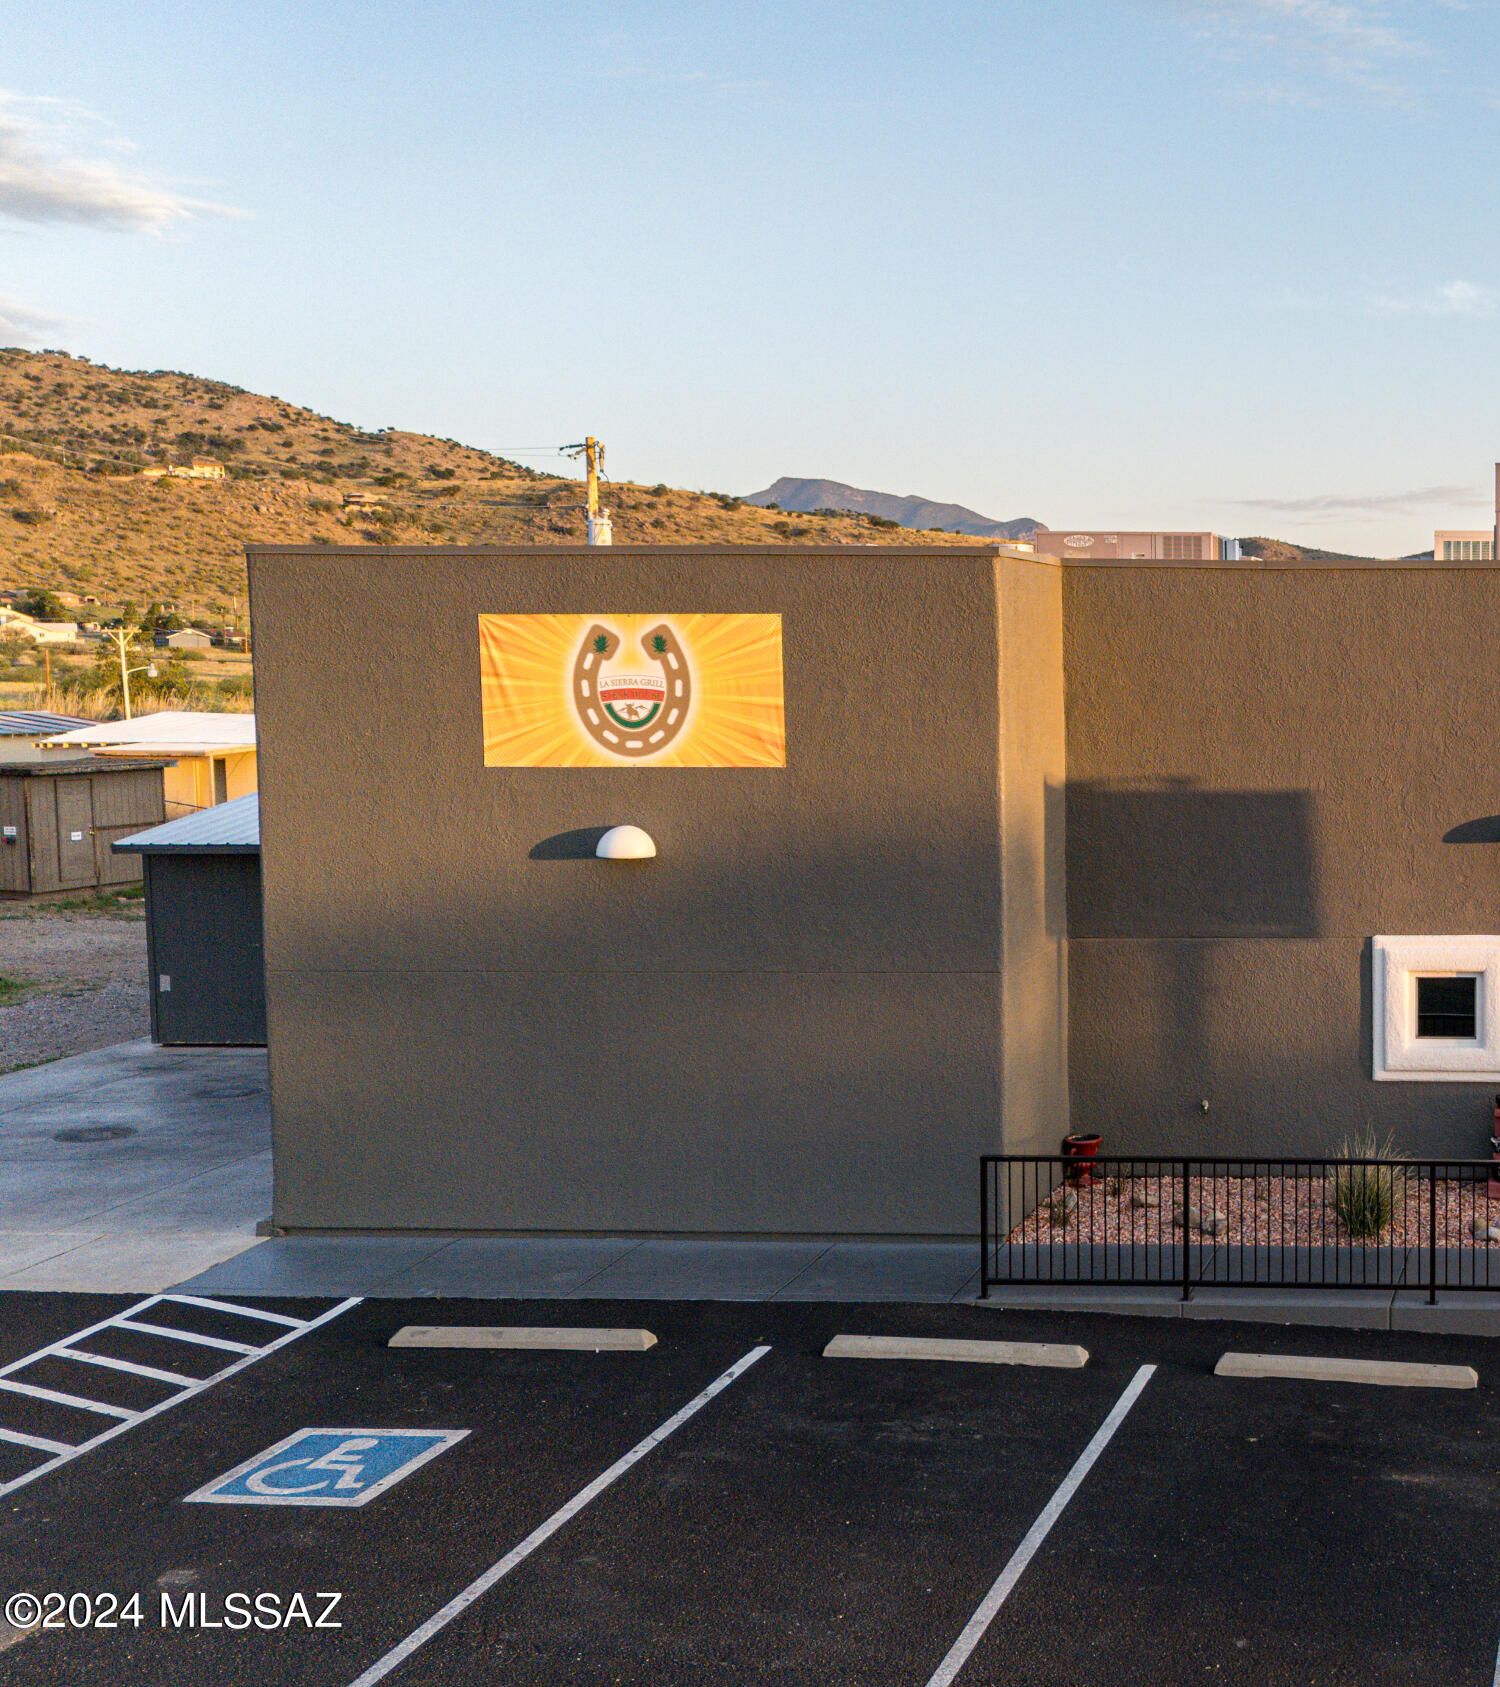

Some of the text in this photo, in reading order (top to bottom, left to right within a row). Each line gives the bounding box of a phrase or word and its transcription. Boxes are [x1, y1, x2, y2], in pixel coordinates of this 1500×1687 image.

[599, 678, 664, 688] LA SIERRA GRILL
